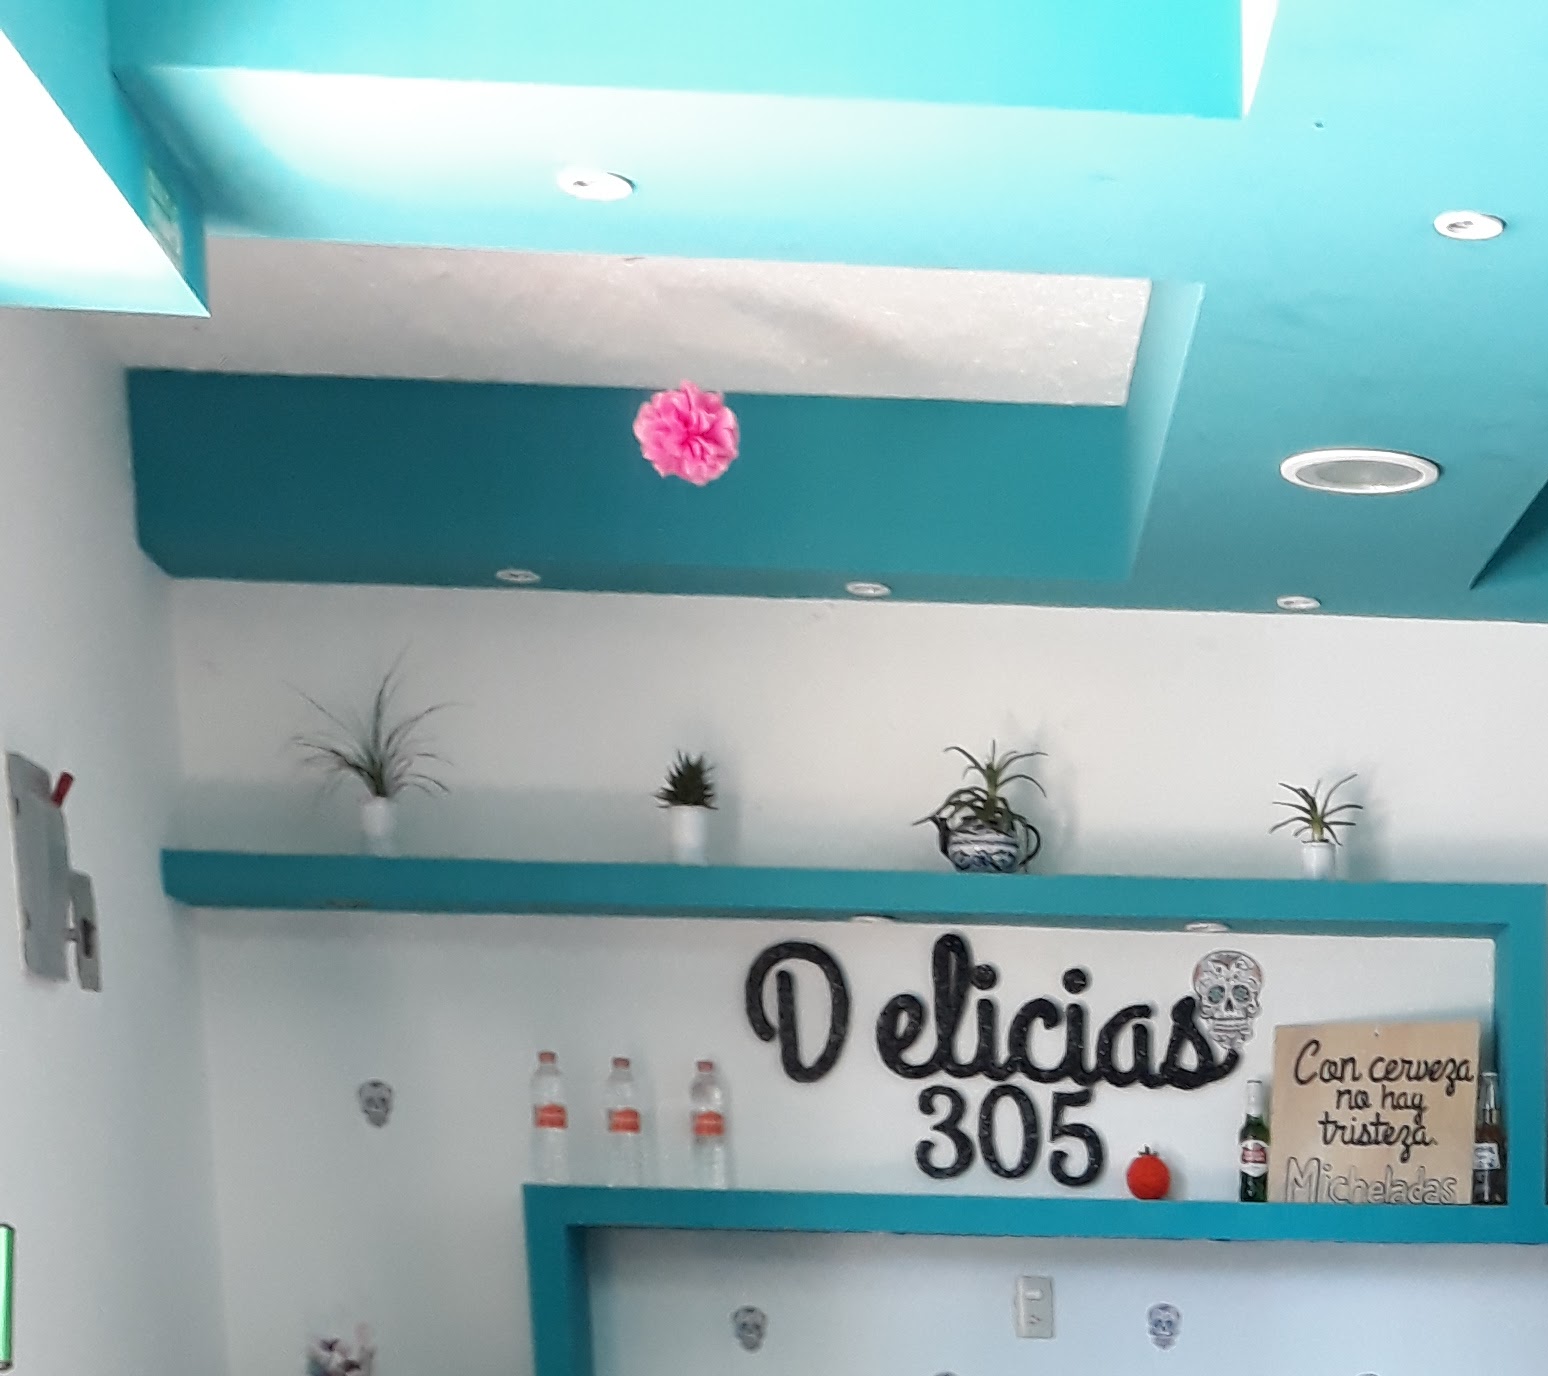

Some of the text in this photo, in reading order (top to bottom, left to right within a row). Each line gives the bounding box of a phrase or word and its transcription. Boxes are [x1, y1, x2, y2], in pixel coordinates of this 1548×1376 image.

[1294, 1039, 1475, 1097] Con cerveza
[1335, 1084, 1428, 1126] no hay
[915, 1085, 1103, 1187] 305
[1285, 1157, 1458, 1204] Micheladas
